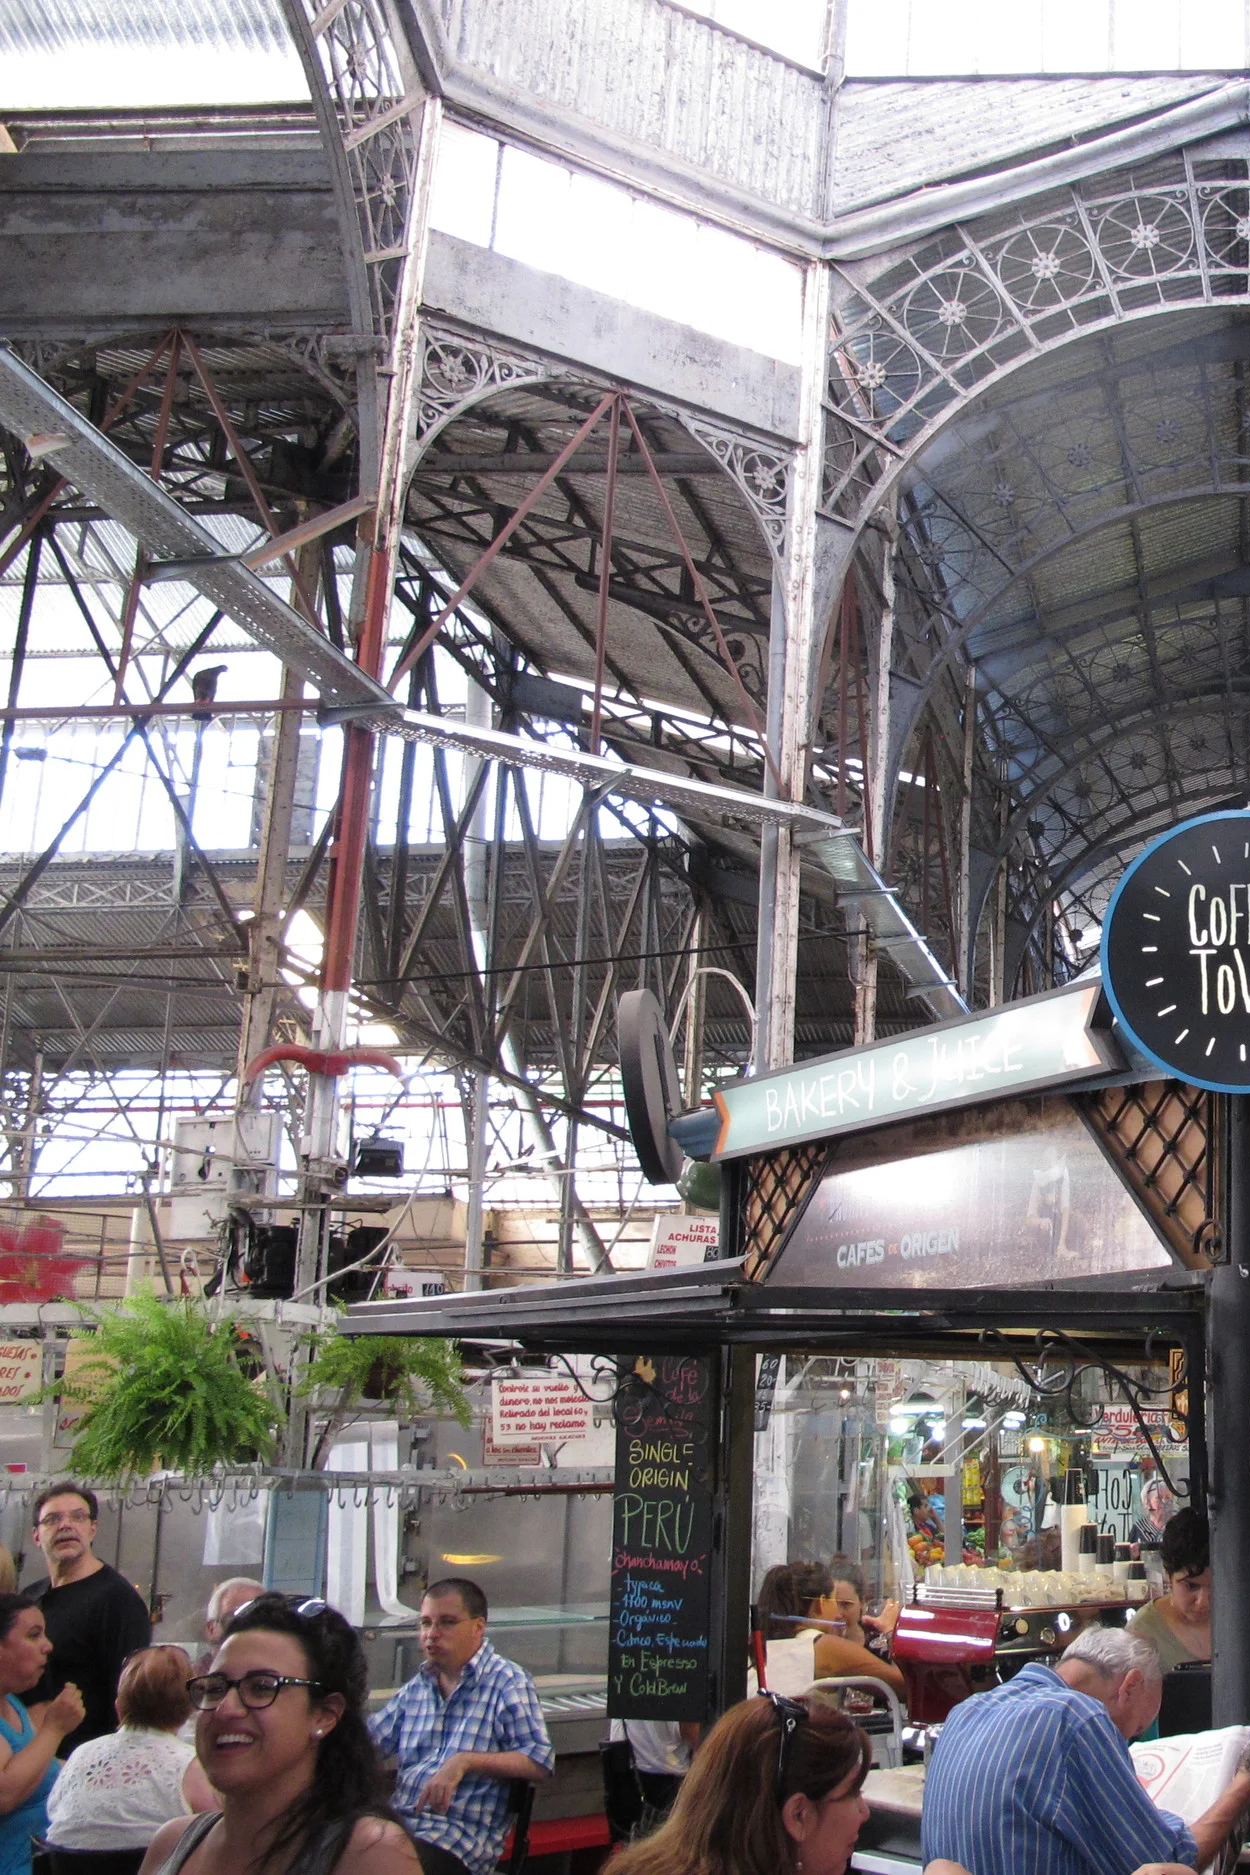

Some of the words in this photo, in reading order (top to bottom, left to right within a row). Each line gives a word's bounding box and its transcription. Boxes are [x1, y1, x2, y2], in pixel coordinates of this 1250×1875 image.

[765, 1058, 876, 1132] BAKERY
[891, 1052, 918, 1101] &
[918, 1036, 1023, 1102] JUICE
[689, 1224, 717, 1234] LISTA
[668, 1233, 716, 1244] ACHURAS
[656, 1244, 678, 1255] LECHON
[836, 1238, 887, 1270] CAFES
[900, 1225, 962, 1261] ORIGEN
[761, 1358, 779, 1370] 60
[498, 1383, 530, 1393] Controle
[531, 1385, 541, 1393] su
[543, 1382, 570, 1392] vuelto
[532, 1397, 543, 1405] no
[544, 1396, 559, 1405] nos
[499, 1408, 537, 1418] Retirado
[537, 1407, 551, 1417] del
[552, 1406, 574, 1416] local
[573, 1407, 584, 1416] 60
[515, 1422, 527, 1431] no
[529, 1420, 547, 1433] hay
[629, 1439, 695, 1466] SINGLE
[629, 1467, 689, 1491] ORIGIN
[614, 1493, 695, 1554] PERÚ
[640, 1649, 698, 1677] Espresso
[614, 1674, 623, 1694] Y
